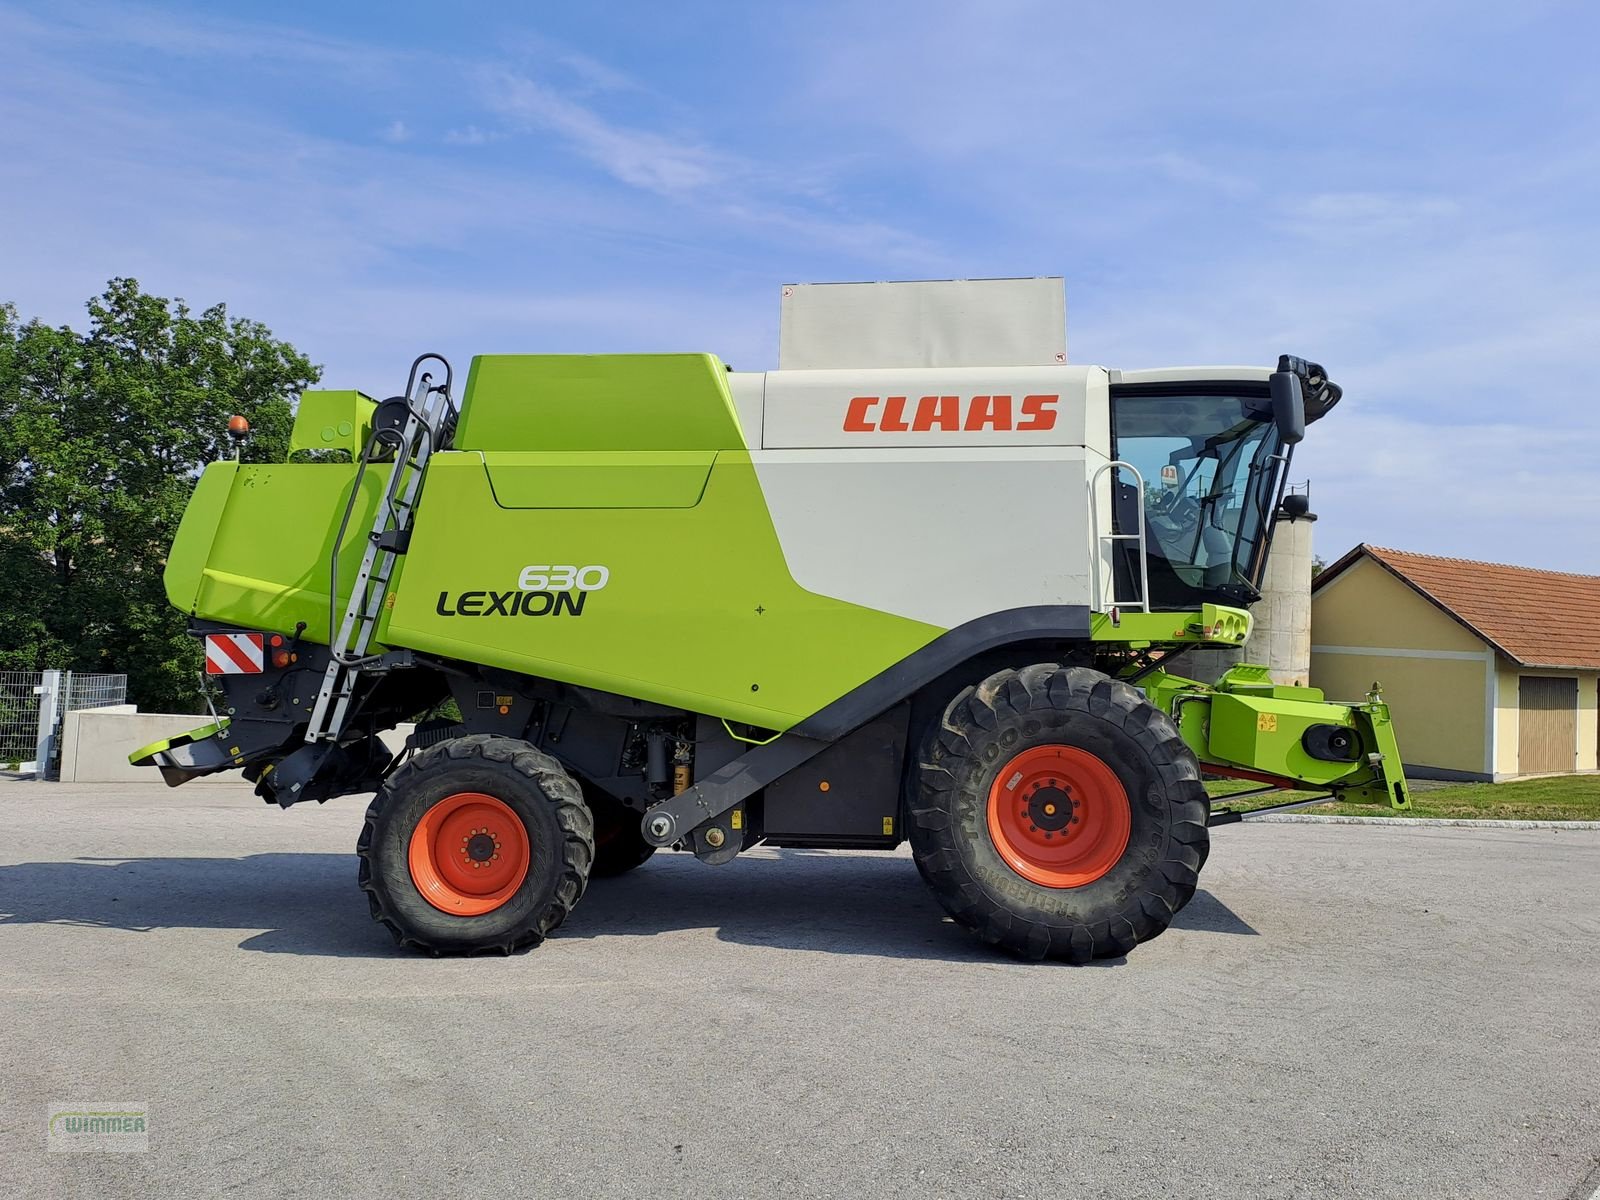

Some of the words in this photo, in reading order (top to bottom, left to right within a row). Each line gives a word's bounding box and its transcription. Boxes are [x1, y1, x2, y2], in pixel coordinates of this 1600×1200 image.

[843, 394, 1059, 432] CLAAS
[518, 565, 610, 591] 630
[436, 591, 587, 616] LEXION
